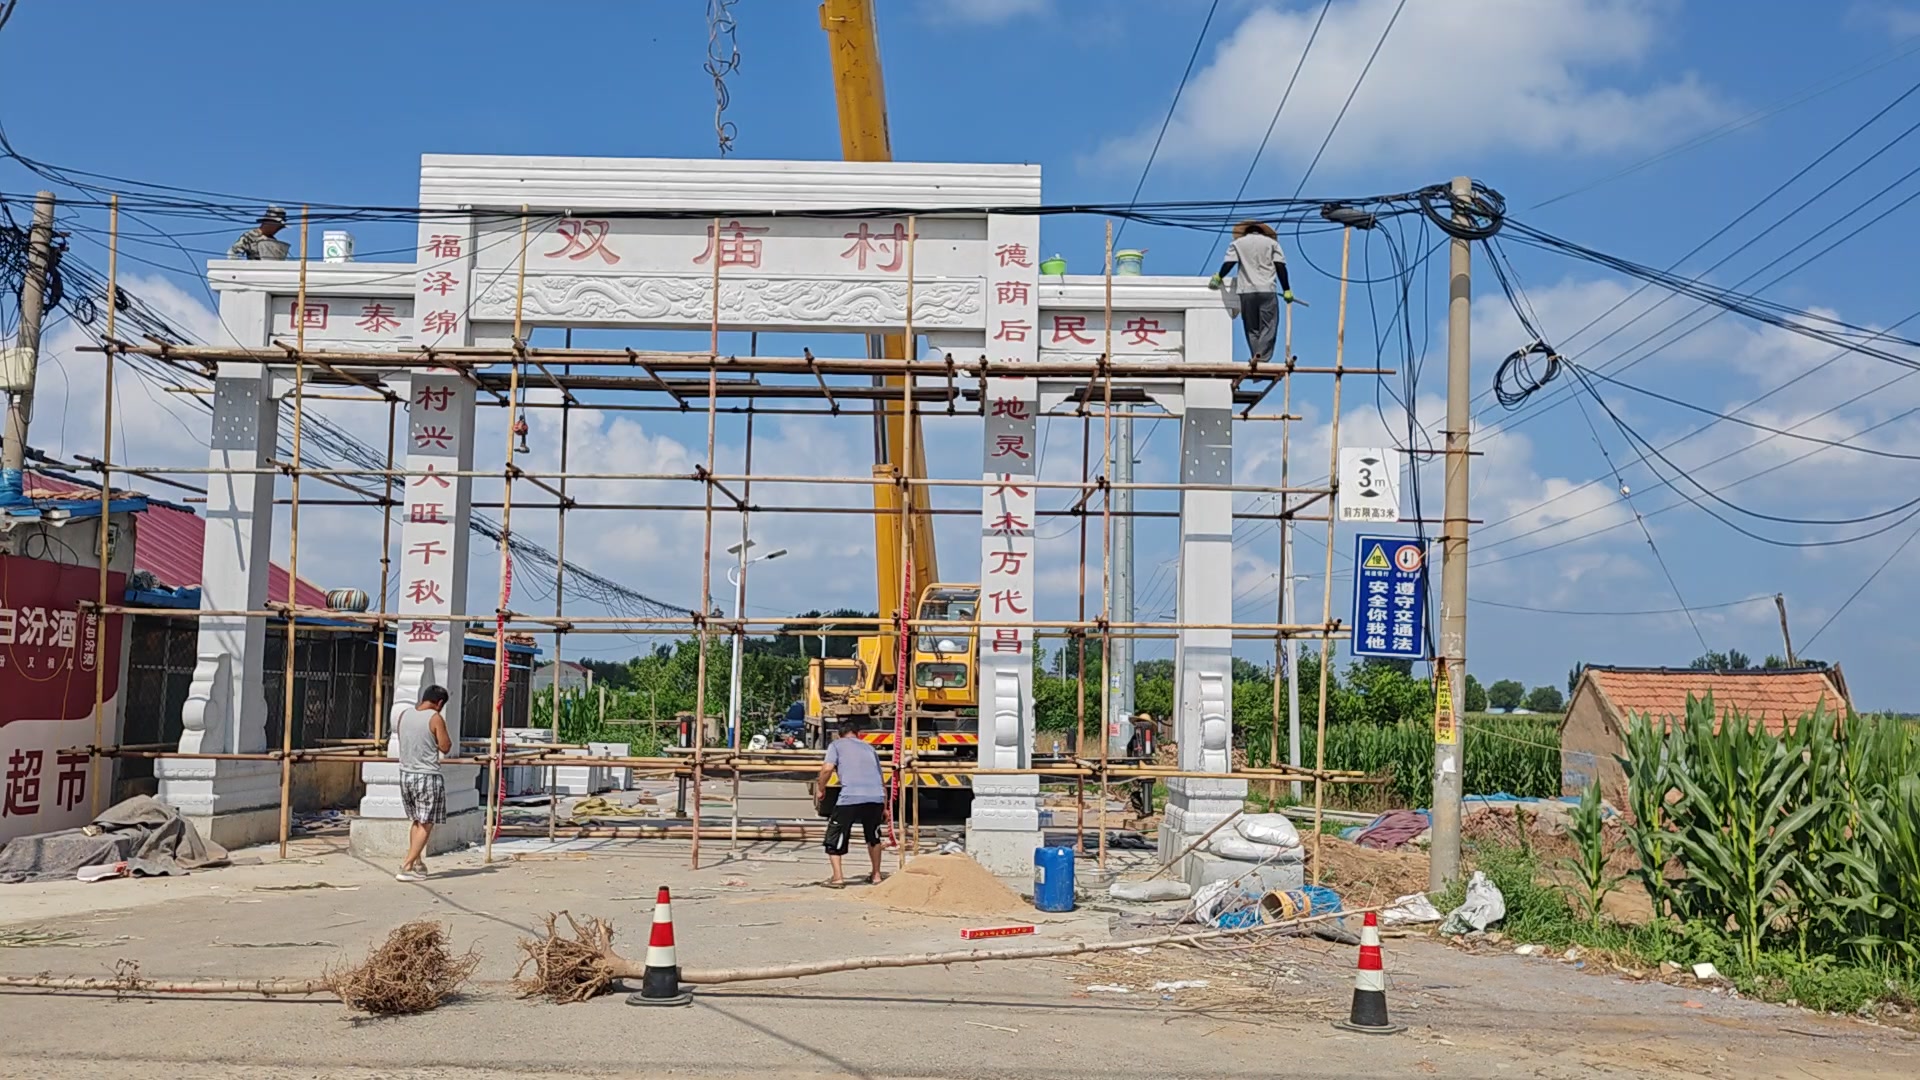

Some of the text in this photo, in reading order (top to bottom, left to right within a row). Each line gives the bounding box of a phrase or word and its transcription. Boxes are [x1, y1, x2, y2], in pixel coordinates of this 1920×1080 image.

[543, 219, 920, 272] 双庙村
[290, 301, 401, 334] 国泰
[1051, 315, 1167, 346] 民安
[403, 234, 462, 643] 福泽绵村兴人旺千秋盛
[1343, 506, 1395, 518] 前方限高3米
[1365, 580, 1389, 650] 安全你我他
[1392, 581, 1415, 651] 遵守交通法
[2, 748, 90, 819] 超市
